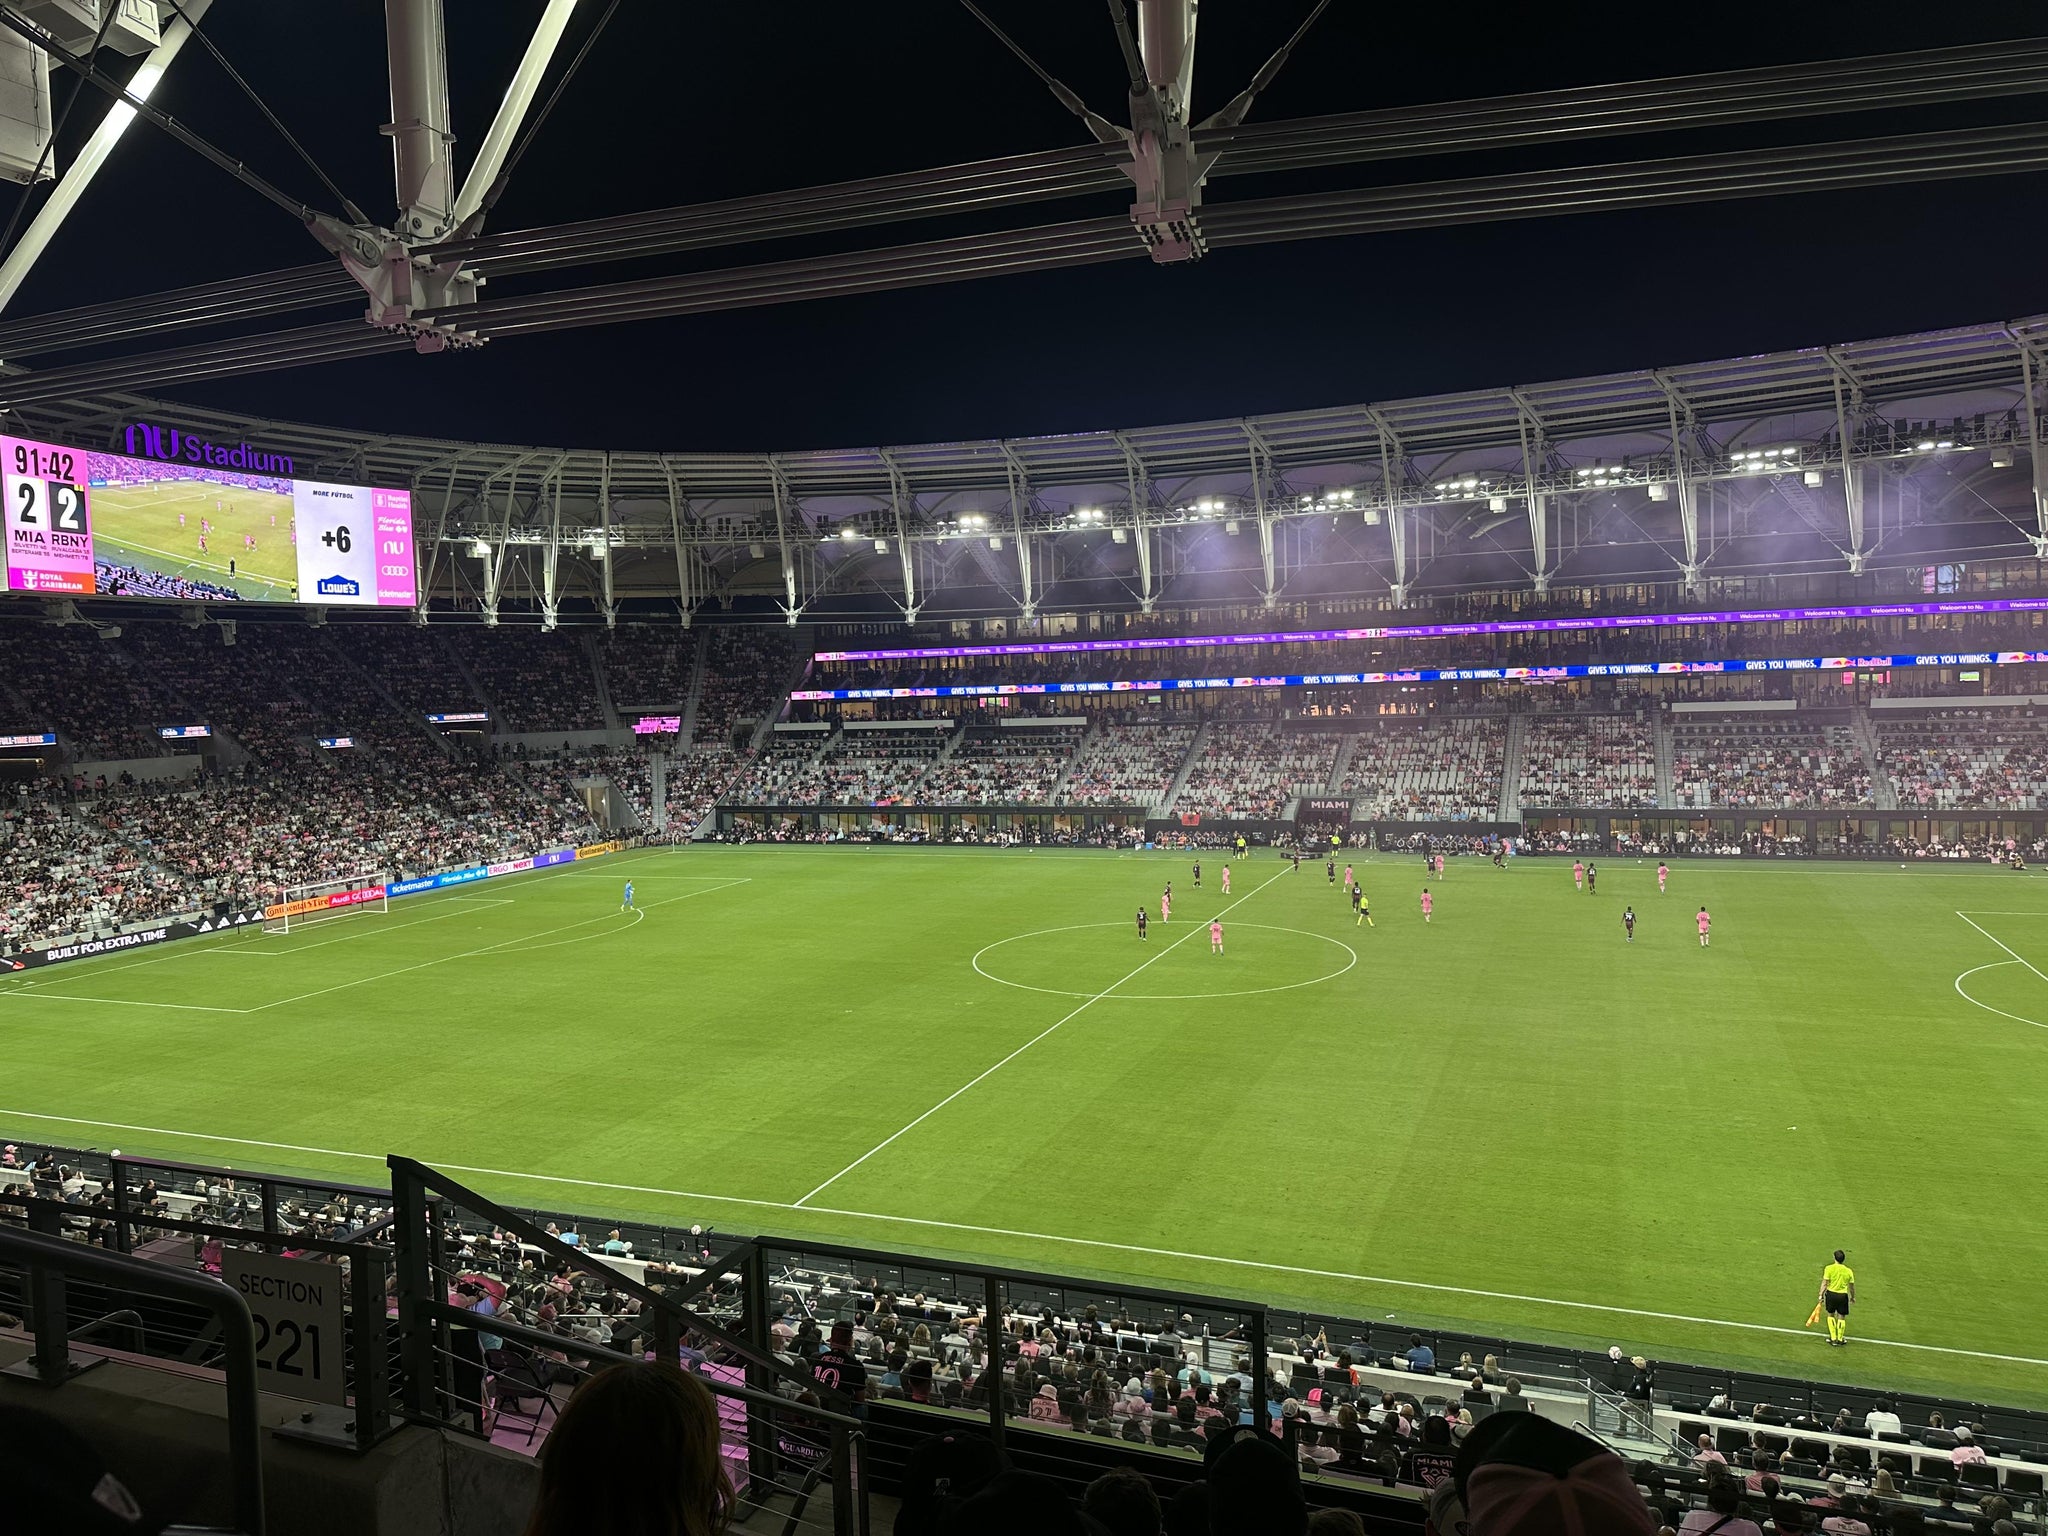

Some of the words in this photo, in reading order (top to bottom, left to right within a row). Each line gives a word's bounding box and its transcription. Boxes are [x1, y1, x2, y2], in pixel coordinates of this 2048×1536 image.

[185, 435, 294, 474] Stadium
[15, 445, 75, 482] 91:42
[19, 483, 36, 524] 2
[58, 488, 78, 529] 2
[14, 530, 46, 544] MIA
[52, 534, 88, 548] RBNY
[322, 526, 351, 553] +6
[40, 573, 64, 581] ROYAL
[40, 580, 82, 590] CARIBBEAN
[1746, 661, 1766, 670] GIVES
[1768, 660, 1783, 669] YOU
[1916, 656, 1938, 664] GIVES
[1940, 656, 1956, 664] YOU
[1588, 666, 1607, 674] GIVES
[489, 865, 508, 874] ERGO
[392, 880, 434, 893] ticketmaster
[332, 895, 350, 904] Audi
[47, 945, 80, 960] BUILT
[81, 940, 104, 954] FOR
[105, 934, 141, 950] EXTRA
[141, 929, 167, 943] TIME
[240, 1273, 322, 1306] SECTION
[252, 1313, 321, 1380] 221
[814, 1366, 840, 1388] 10
[785, 1443, 824, 1458] GUARDIAN
[1417, 1458, 1453, 1467] MIAMI
